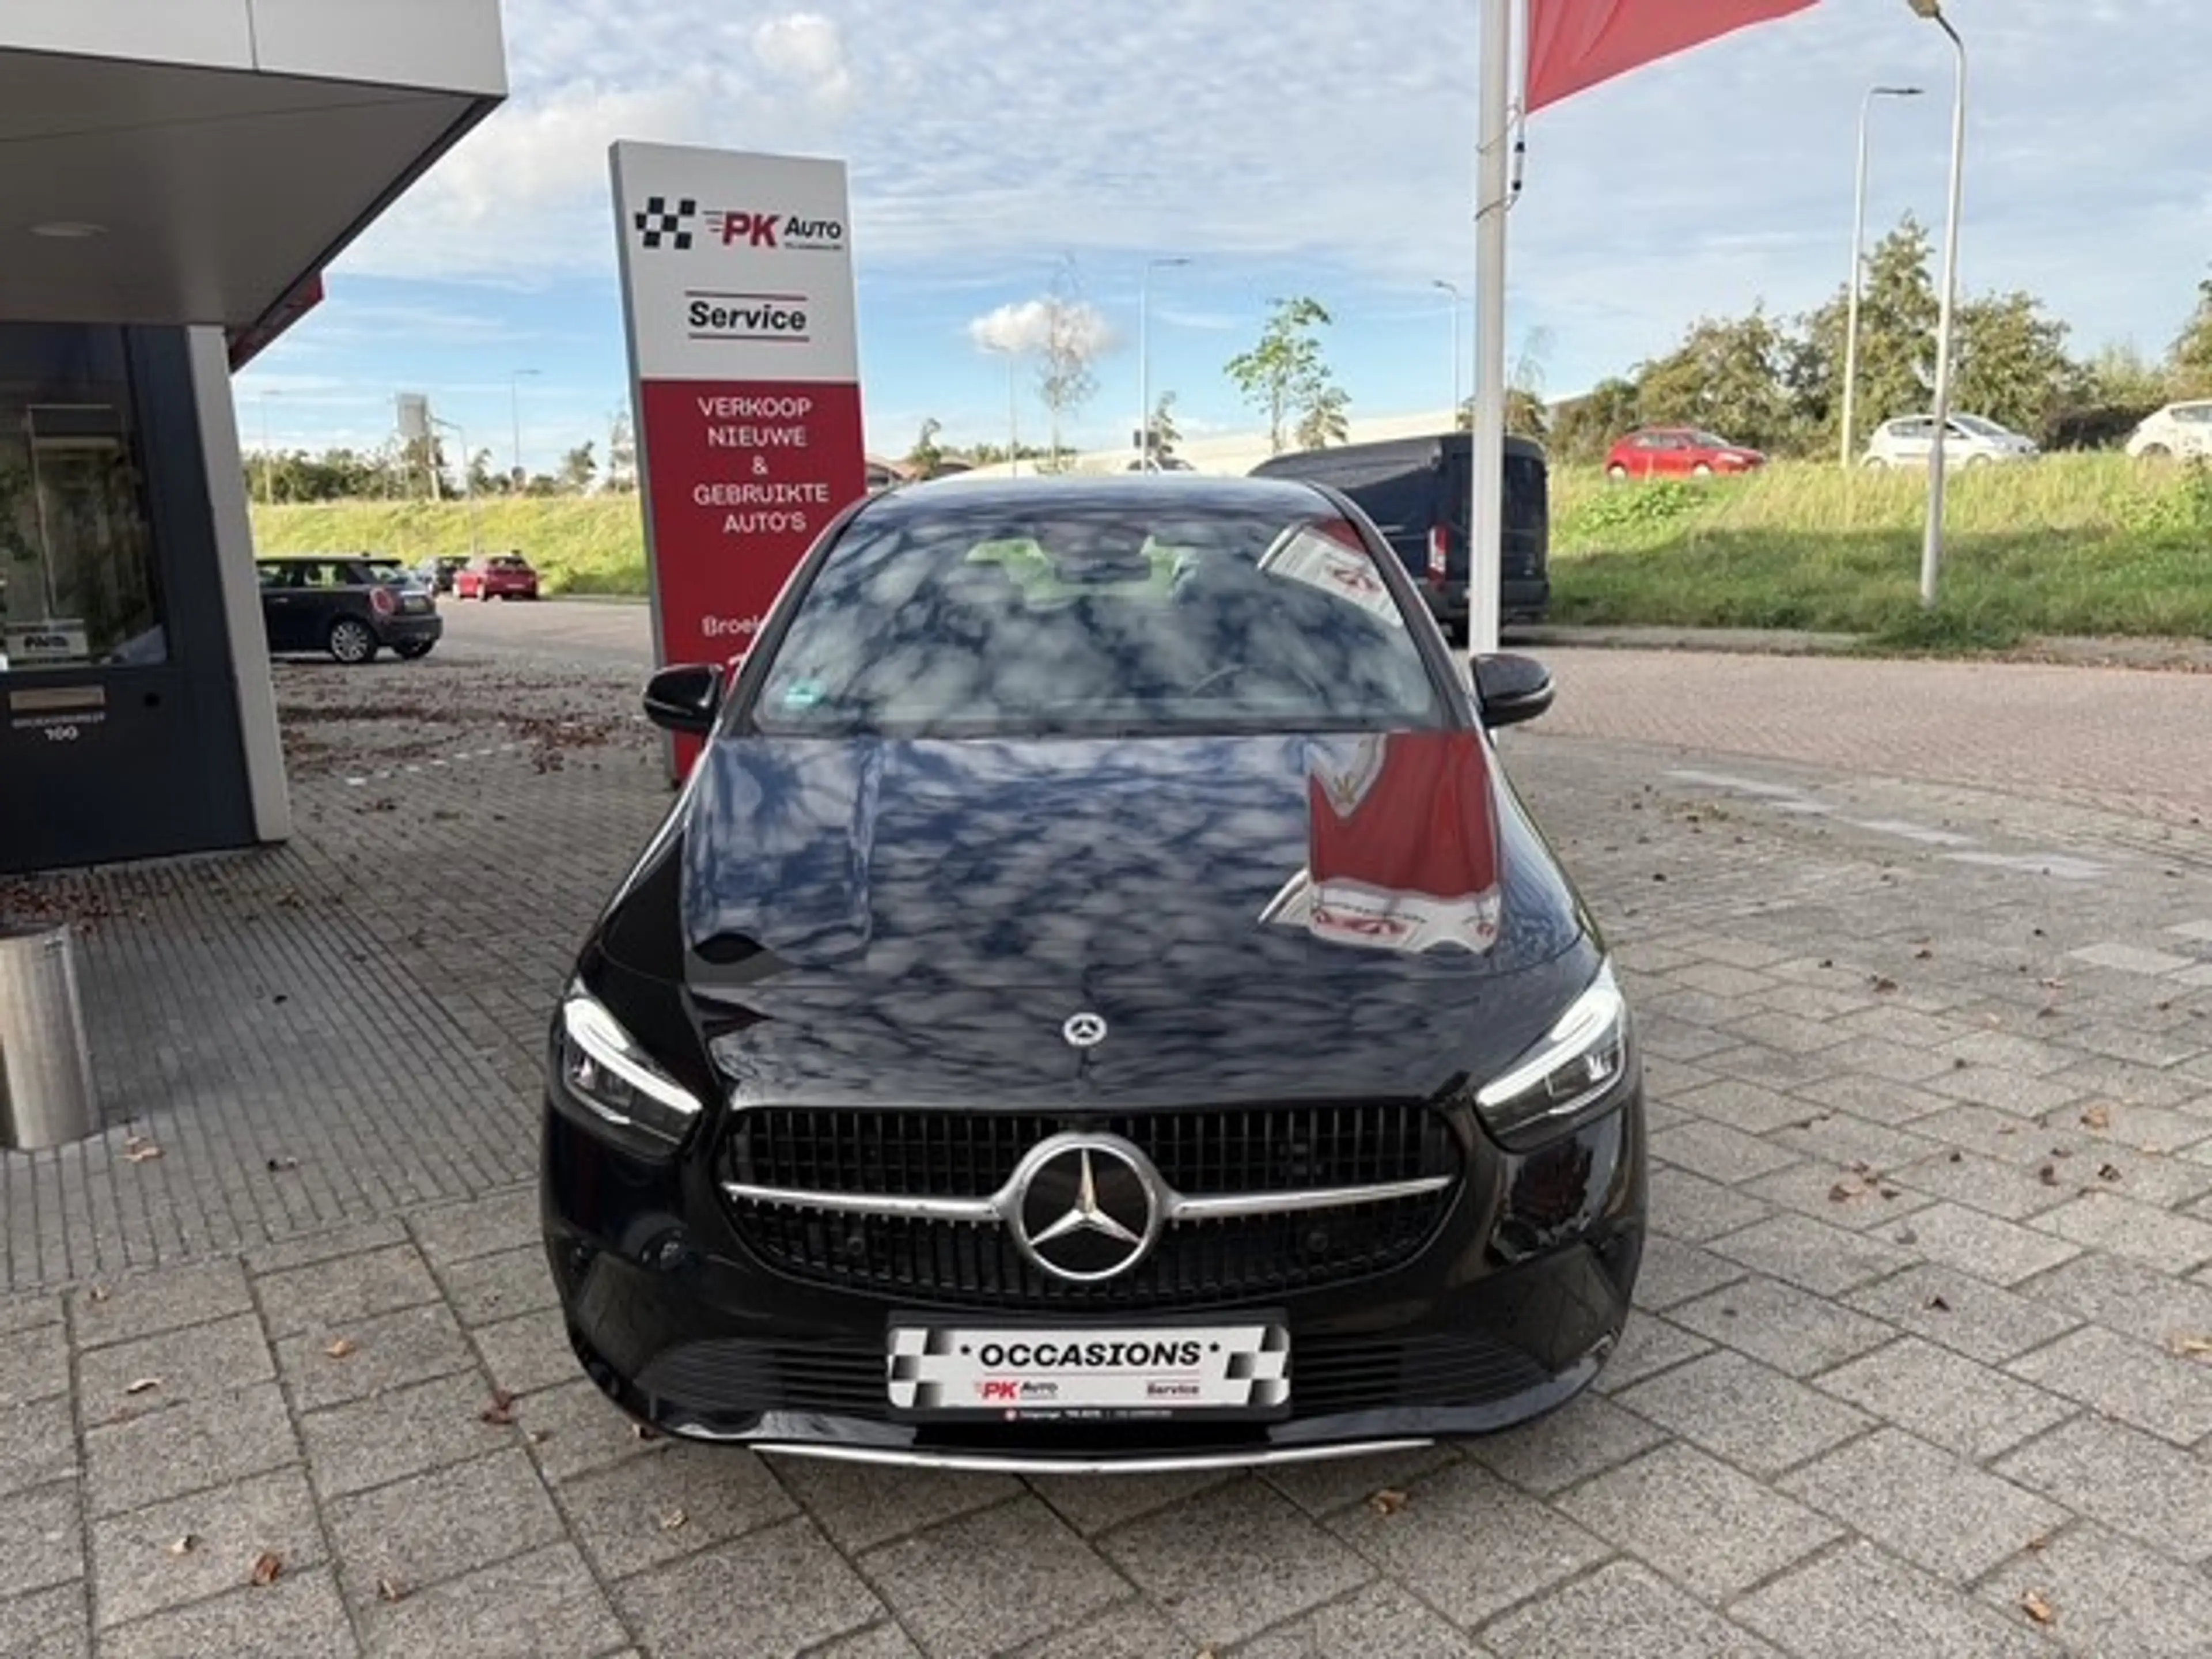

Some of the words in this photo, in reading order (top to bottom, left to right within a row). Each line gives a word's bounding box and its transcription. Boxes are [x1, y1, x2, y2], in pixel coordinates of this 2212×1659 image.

[723, 211, 780, 247] PK
[688, 300, 806, 332] Service
[698, 397, 812, 418] VERKOOP
[708, 427, 807, 446] NIEUWE
[753, 455, 768, 475] &
[694, 483, 830, 505] GEBRUIKTE
[724, 512, 806, 533] AUTO'S
[979, 1341, 1201, 1367] OCCASIONS
[982, 1381, 1019, 1400] PK
[1146, 1384, 1200, 1395] Service
